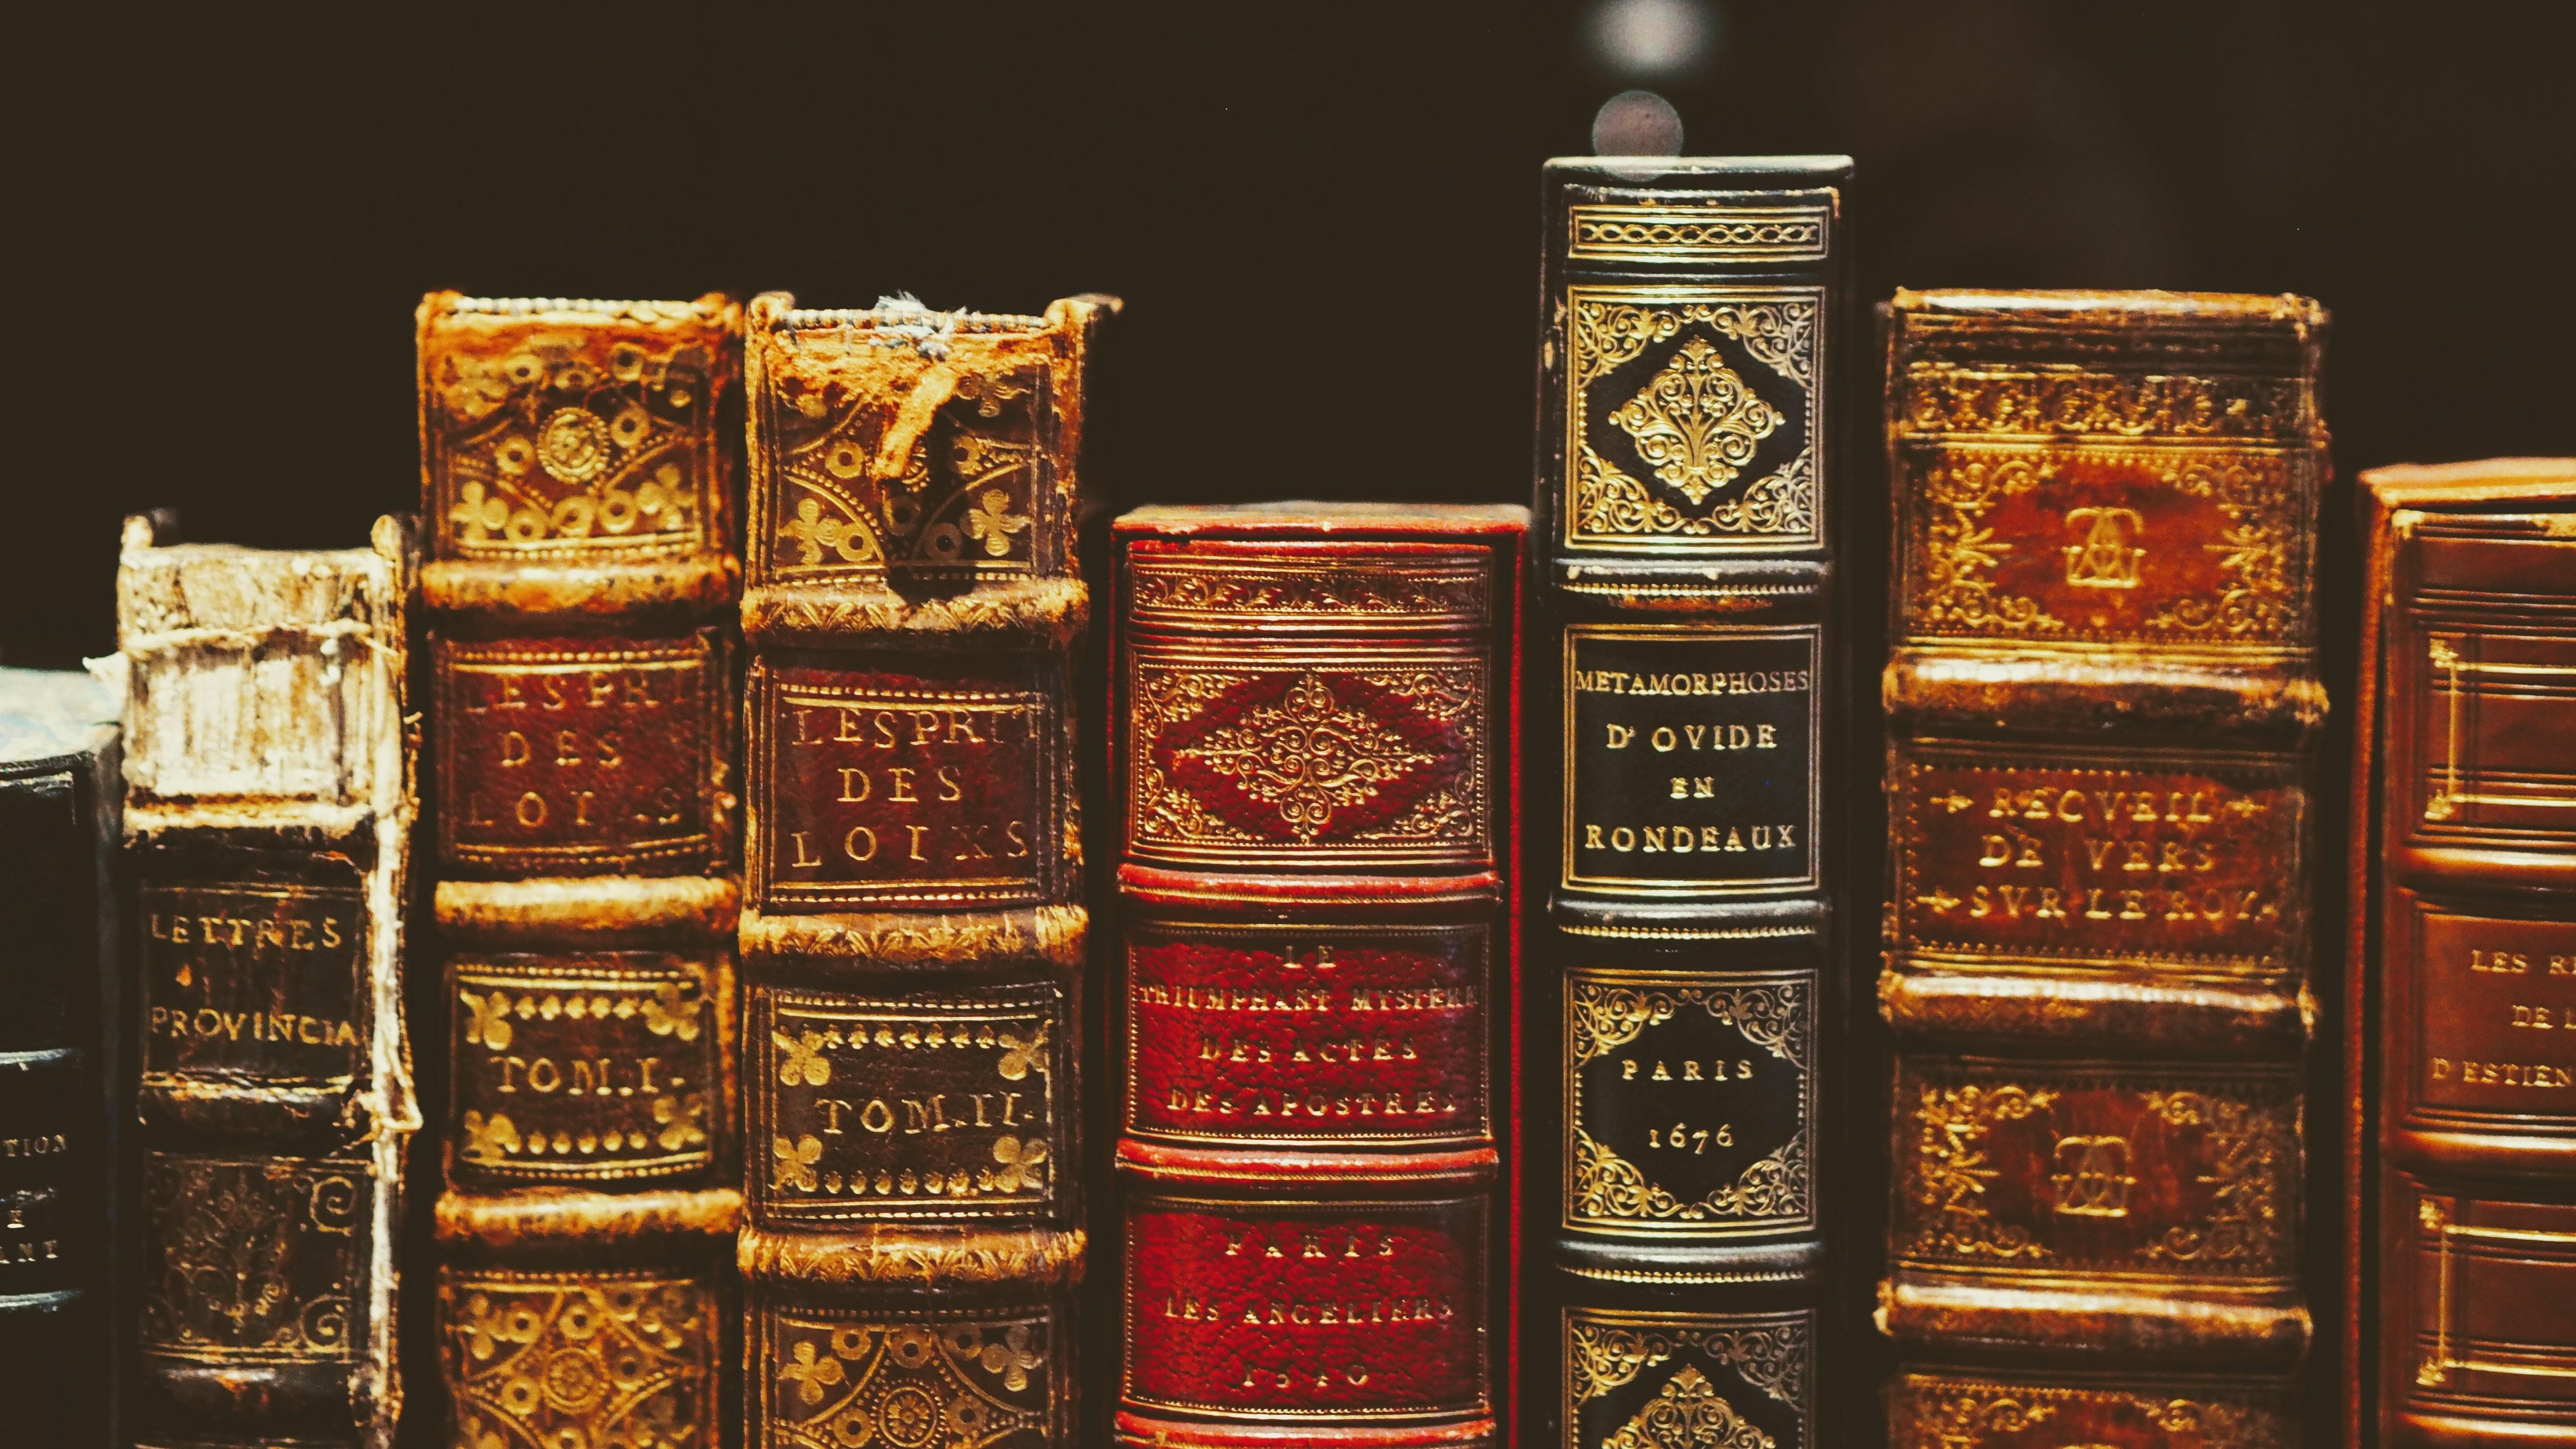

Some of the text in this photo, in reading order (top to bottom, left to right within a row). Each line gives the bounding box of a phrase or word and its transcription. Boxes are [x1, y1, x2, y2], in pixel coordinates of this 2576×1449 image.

[1575, 670, 1810, 697] METAMORPHOSES
[500, 731, 622, 768] DES
[836, 766, 962, 802] DES
[1669, 775, 1715, 799] EN
[1988, 788, 2214, 823] RECVEIL
[1584, 825, 1797, 853] RONDEAUX
[1979, 835, 2215, 873] DE VERS
[1970, 886, 2067, 920] SVR
[2085, 889, 2148, 921] LE
[151, 913, 342, 950] LETTRES
[1284, 946, 1337, 969] LE
[2470, 949, 2530, 974] LES
[151, 1006, 359, 1047] PROVINCIA
[2512, 1005, 2554, 1030] DE
[1199, 1037, 1417, 1063] DES ACTES
[1622, 1059, 1754, 1081] PARIS
[1167, 1088, 1233, 1114] DES
[2, 1133, 68, 1157] TION
[1649, 1123, 1734, 1155] 1676
[1225, 1234, 1394, 1258] PARIS
[1164, 1297, 1219, 1321] LES
